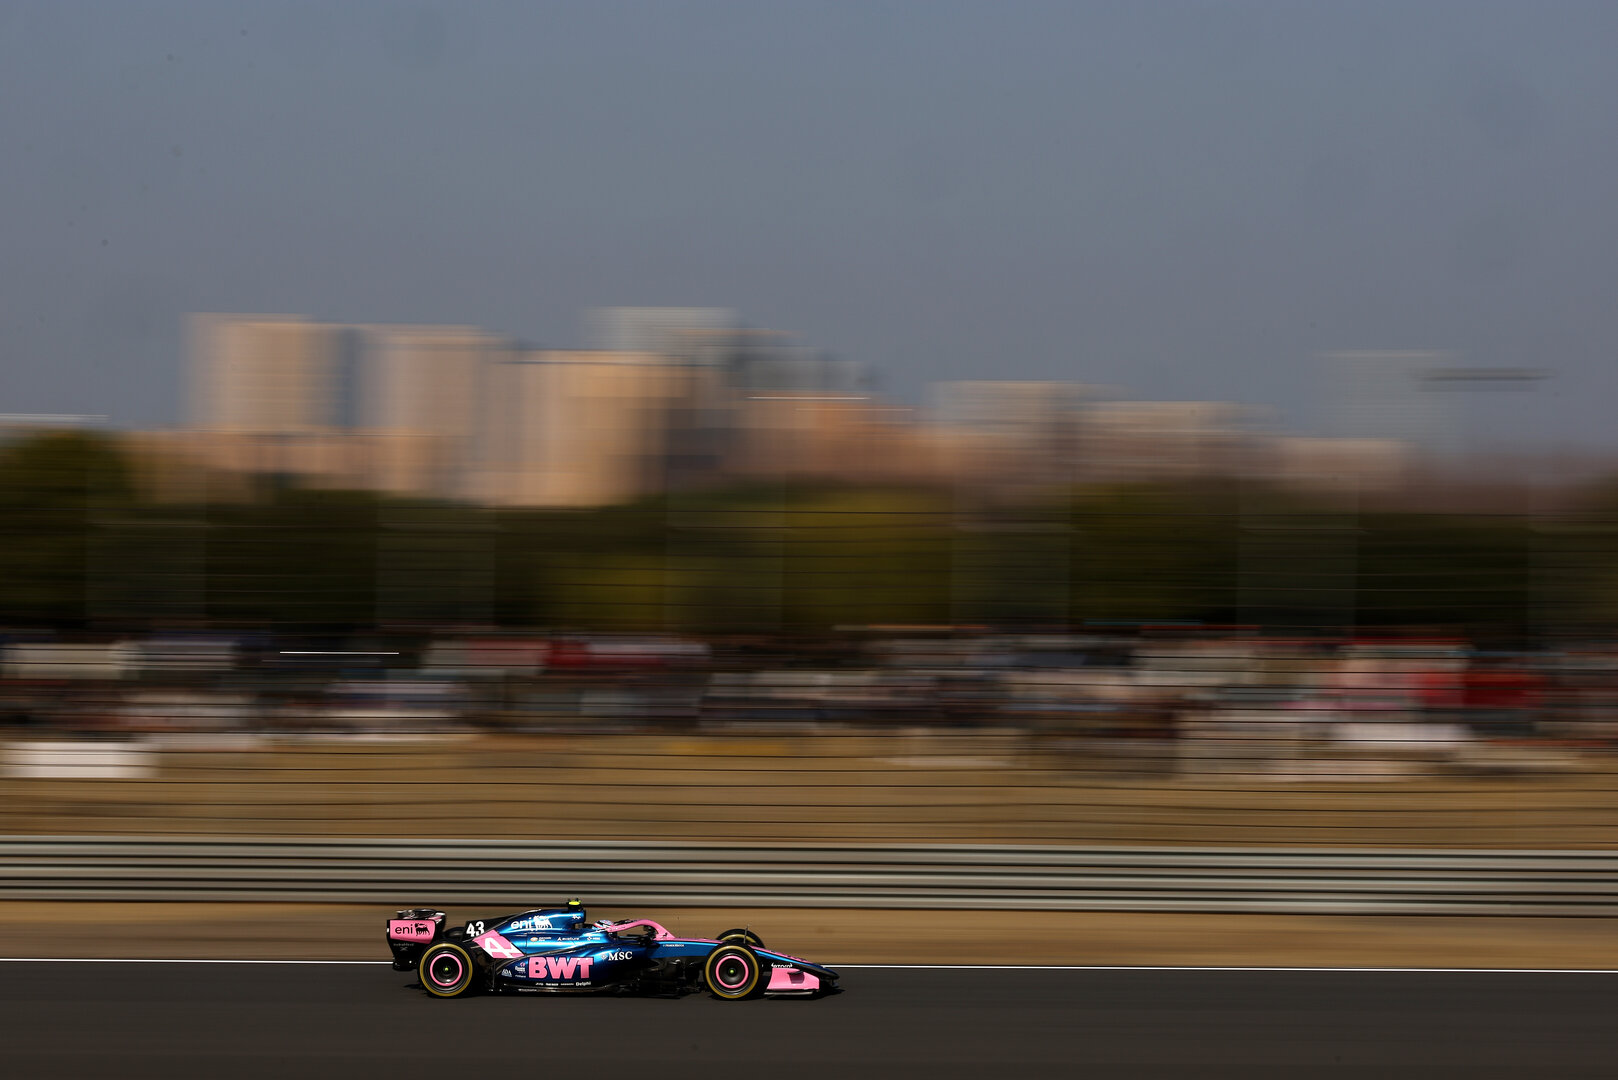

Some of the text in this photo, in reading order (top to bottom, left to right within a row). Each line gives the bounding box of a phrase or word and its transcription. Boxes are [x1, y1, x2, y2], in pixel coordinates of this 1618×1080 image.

[466, 921, 484, 937] 43
[511, 917, 532, 929] eni
[395, 924, 413, 935] eni
[608, 951, 633, 961] MSC
[529, 957, 594, 979] BWT
